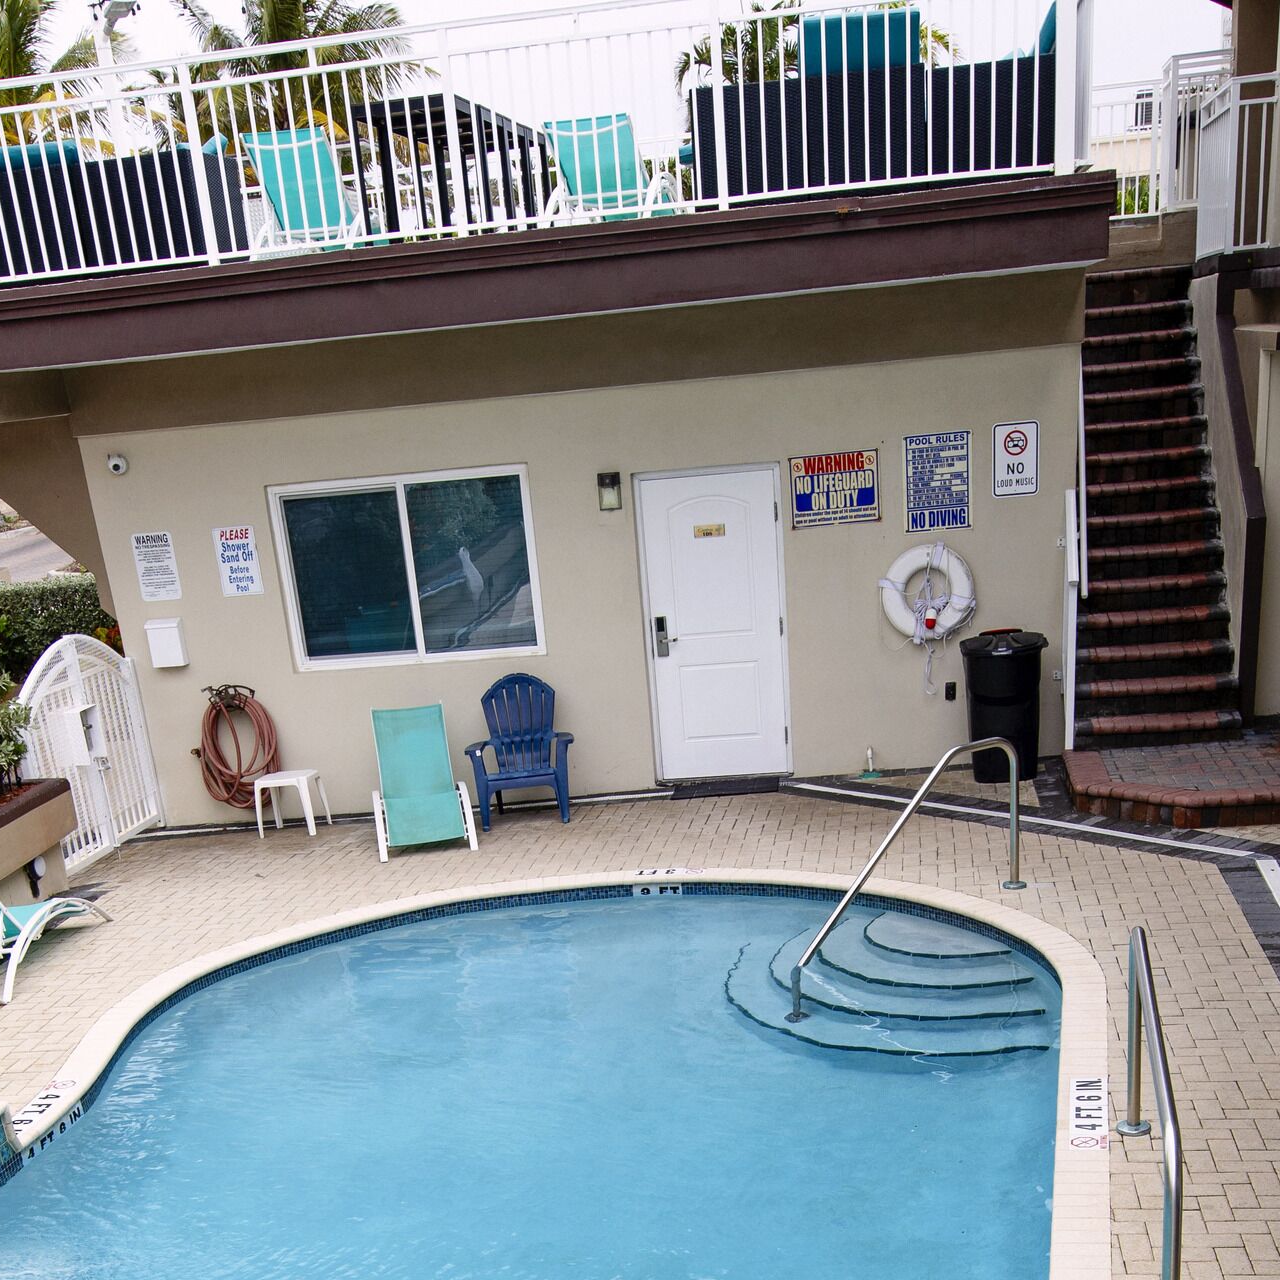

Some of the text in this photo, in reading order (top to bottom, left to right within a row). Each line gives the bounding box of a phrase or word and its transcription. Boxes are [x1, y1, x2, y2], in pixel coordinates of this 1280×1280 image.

[909, 434, 965, 447] POOL RULES
[803, 452, 864, 475] WARNING
[1007, 462, 1024, 475] NO
[796, 470, 873, 495] NO LIFEGUARD
[997, 477, 1034, 488] LOUD MUSIC
[812, 489, 859, 511] ON DUTY
[911, 508, 966, 529] NO DIVING
[134, 534, 168, 545] WARNING
[220, 528, 249, 541] PLEASE
[222, 542, 249, 552] Shower
[221, 551, 253, 564] Sand Off
[230, 566, 249, 574] Before
[229, 575, 254, 584] Entering
[237, 584, 249, 592] Pool
[1075, 1078, 1102, 1091] IN.
[1075, 1106, 1103, 1119] FT.
[28, 1146, 35, 1159] 4
[60, 1122, 66, 1134] 6
